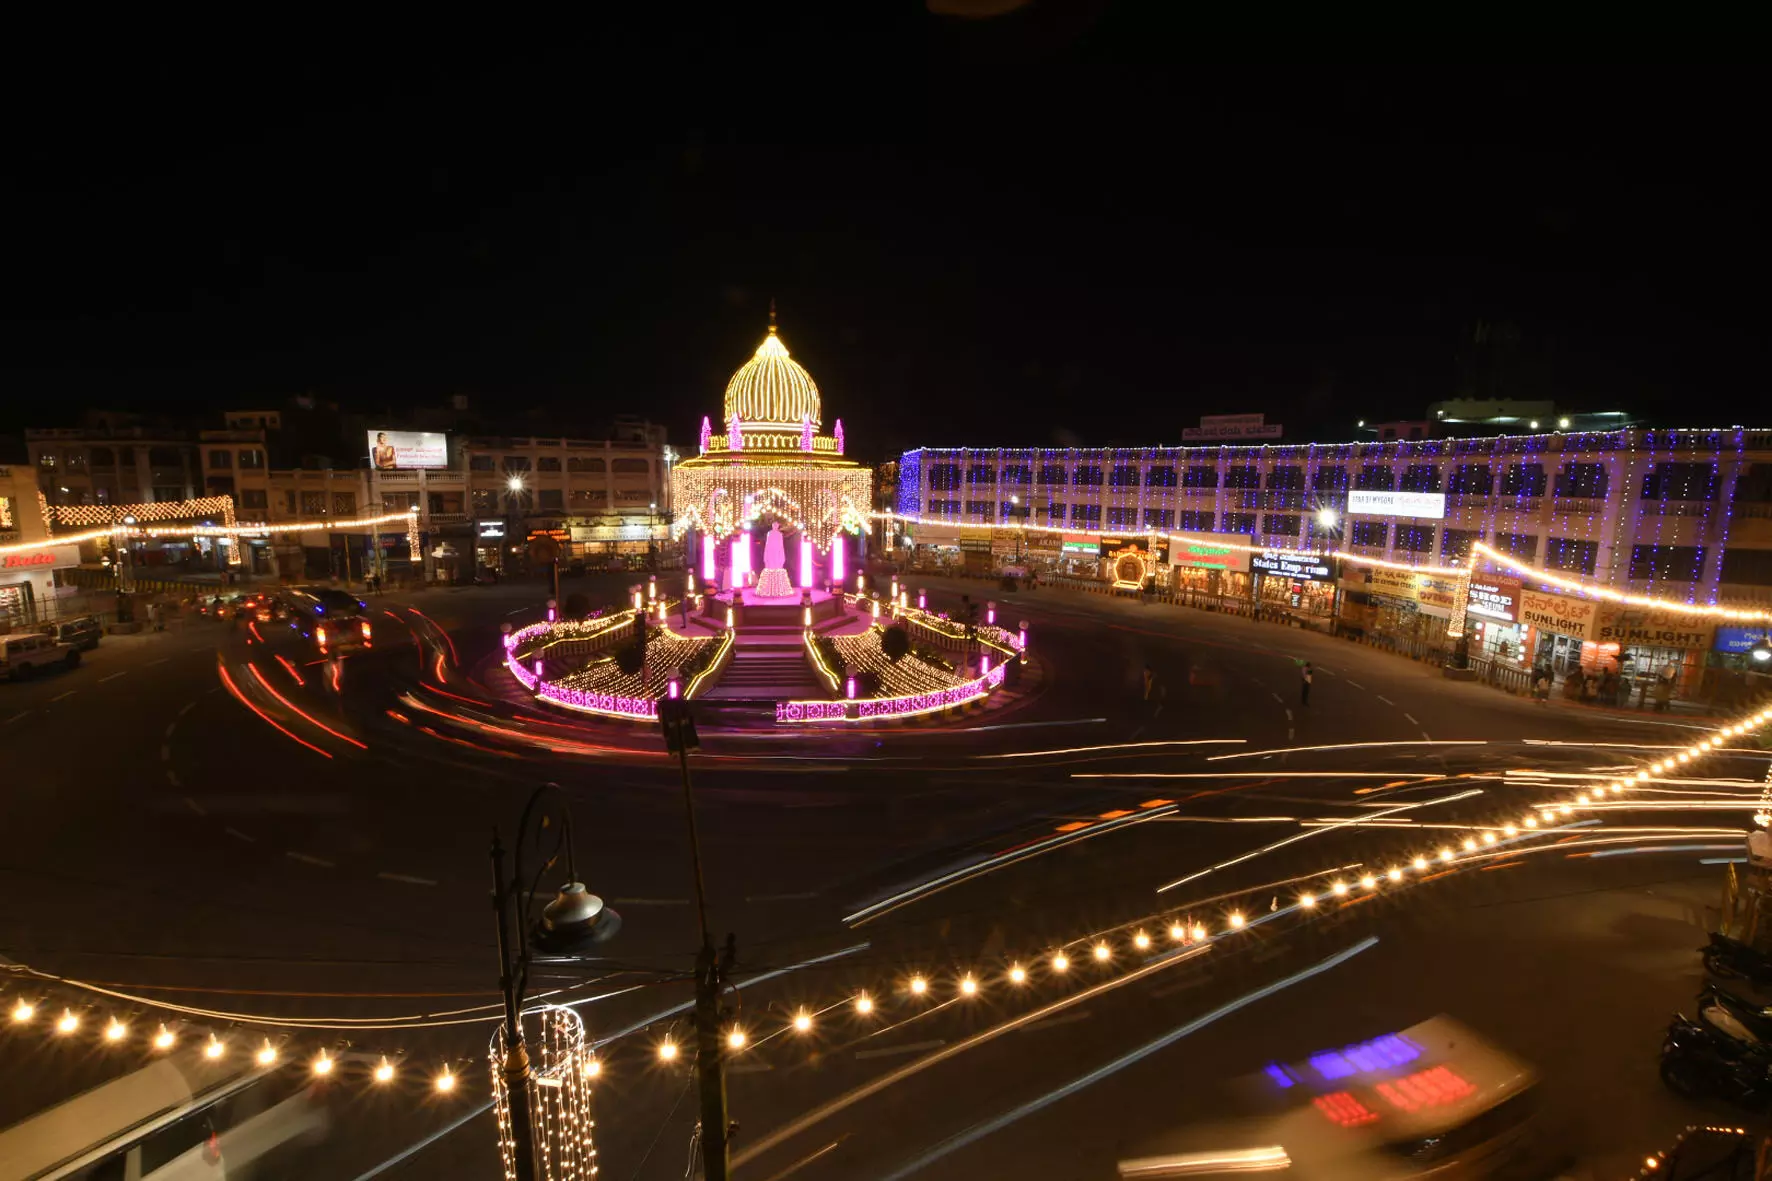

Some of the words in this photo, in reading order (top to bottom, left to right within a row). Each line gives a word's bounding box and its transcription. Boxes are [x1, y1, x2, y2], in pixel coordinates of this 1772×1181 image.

[4, 553, 56, 568] Bata
[1469, 590, 1512, 606] SHOE
[1524, 611, 1585, 633] SUNLIGHT
[1599, 627, 1706, 643] SUNLIGHT
